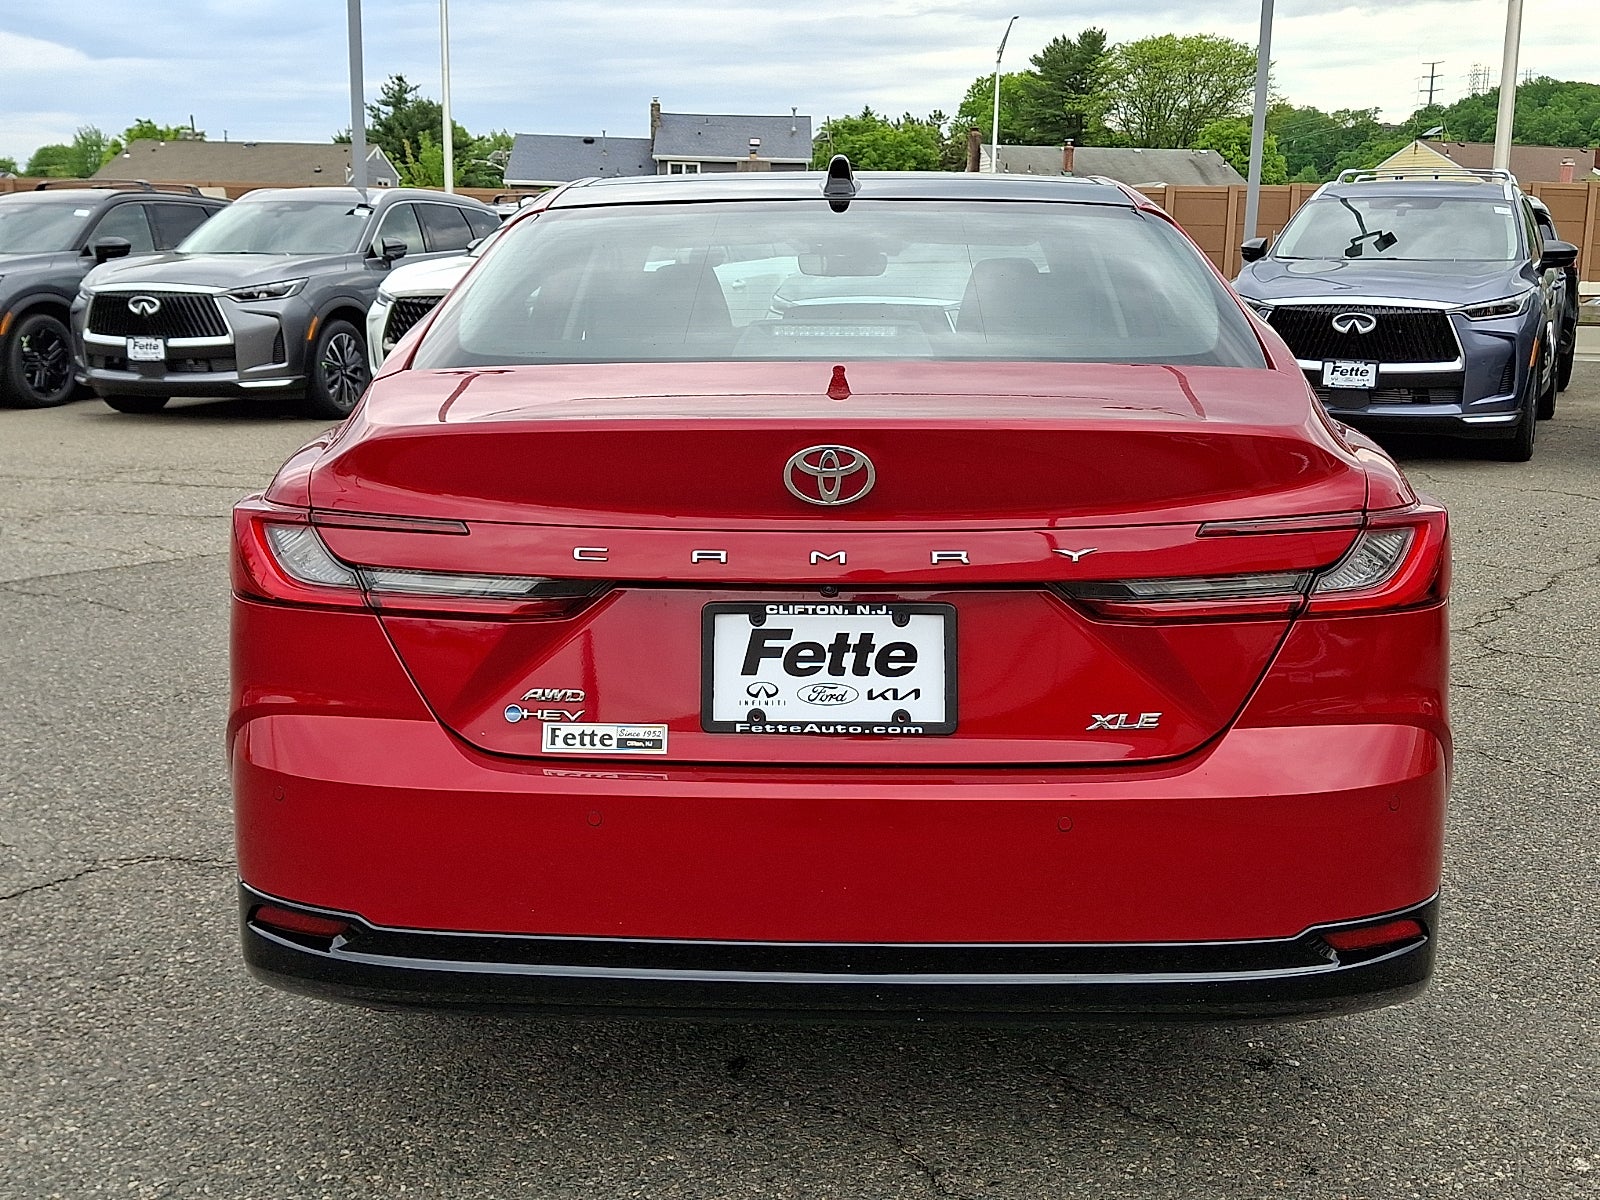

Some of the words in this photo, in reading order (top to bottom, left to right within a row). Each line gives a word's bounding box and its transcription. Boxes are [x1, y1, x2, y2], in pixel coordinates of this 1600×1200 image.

[132, 341, 159, 350] Fette
[1330, 365, 1369, 377] Fette
[572, 546, 1098, 565] CAMRY
[765, 604, 849, 616] CLIFTON,
[856, 605, 893, 615] N.J.
[740, 628, 918, 678] Fette
[520, 688, 586, 702] AWD
[807, 685, 848, 703] Ford
[867, 688, 921, 701] KIA
[522, 709, 586, 722] HEV
[1085, 712, 1163, 731] XLE
[618, 728, 641, 737] Since
[643, 730, 662, 738] 1952
[735, 723, 924, 734] FetteAuto.com
[550, 727, 614, 747] Fette
